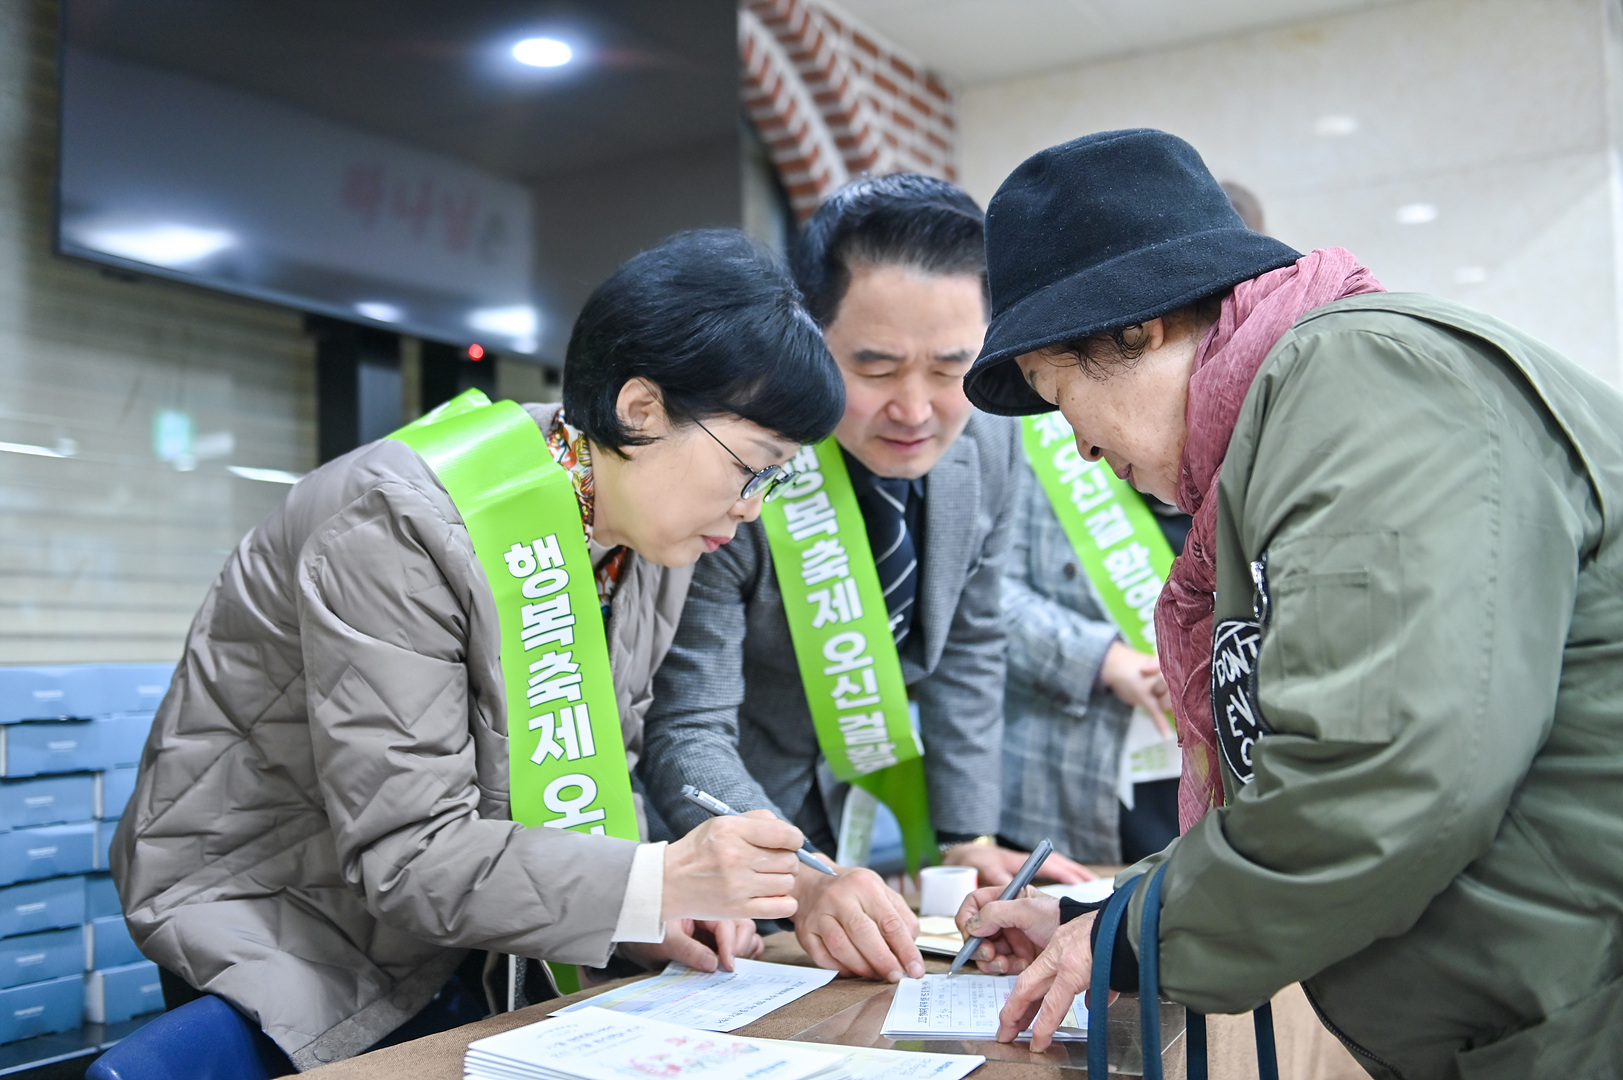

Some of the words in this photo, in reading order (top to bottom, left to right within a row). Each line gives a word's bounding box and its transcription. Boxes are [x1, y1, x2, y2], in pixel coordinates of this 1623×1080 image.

[503, 533, 597, 766] 행복축제
[822, 631, 881, 710] 오신
[543, 773, 606, 836] 오
